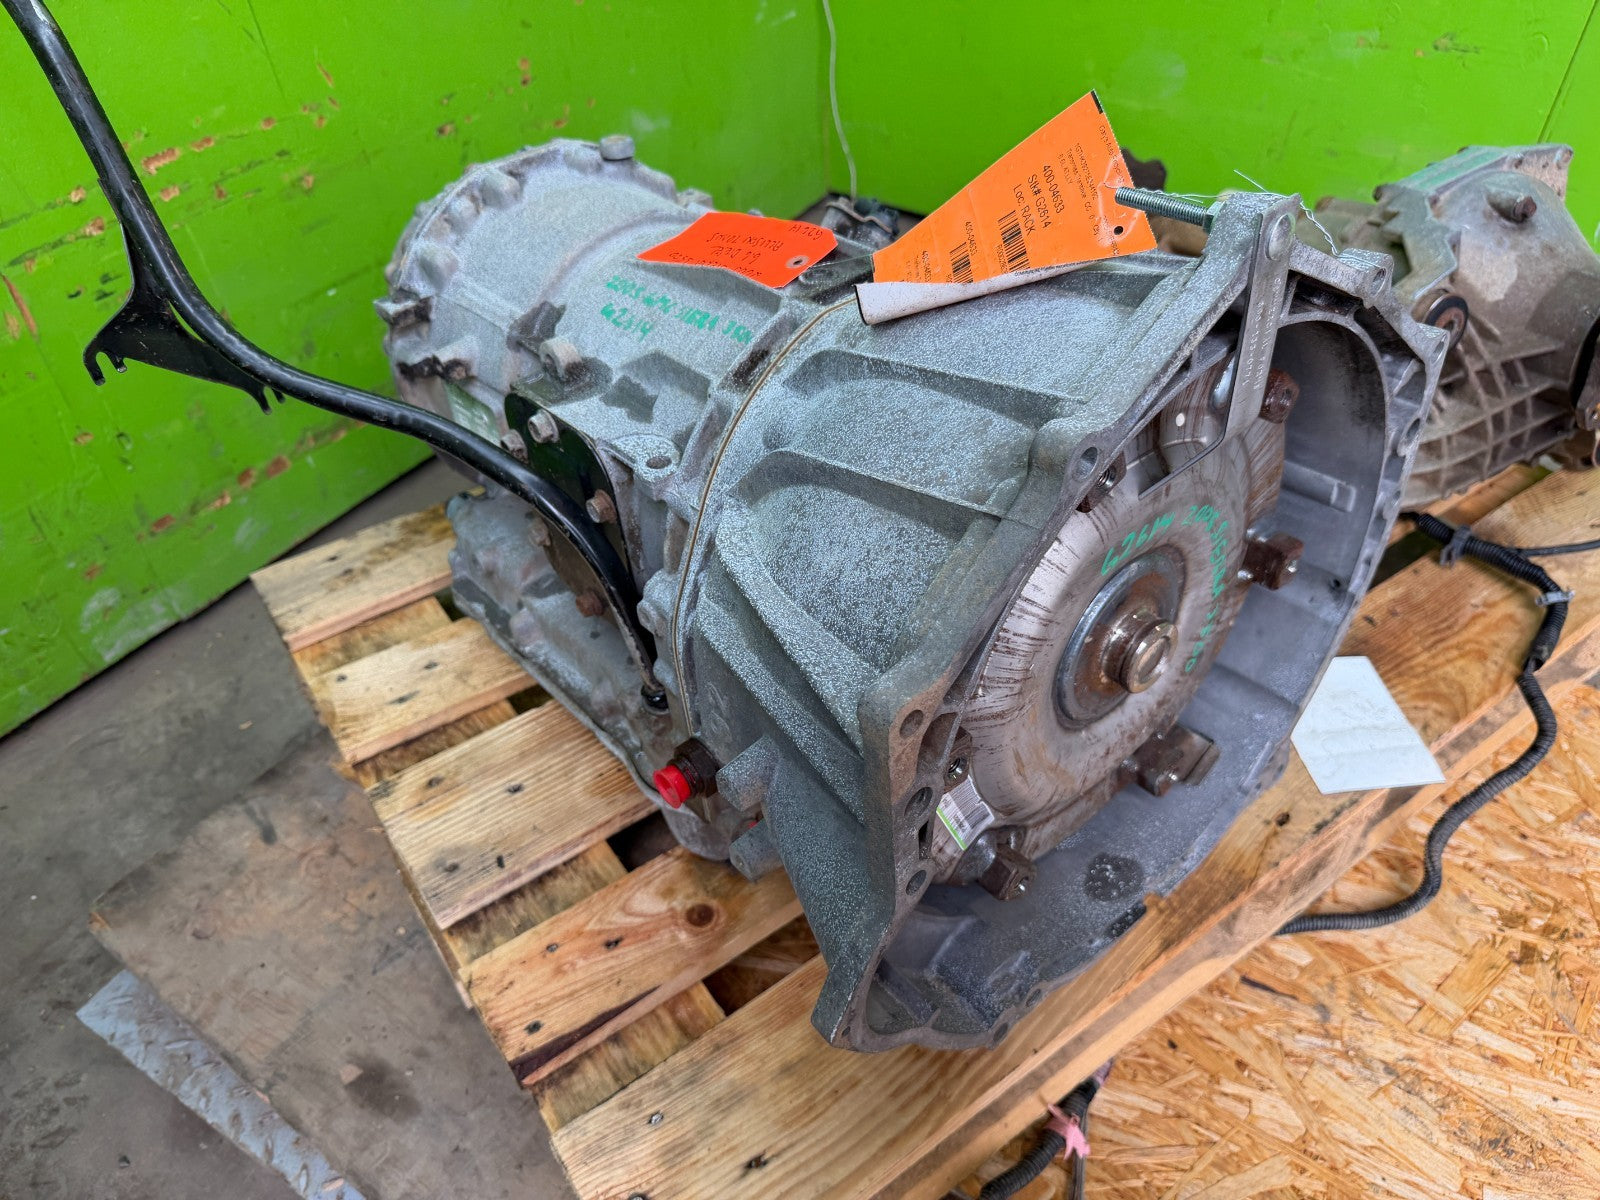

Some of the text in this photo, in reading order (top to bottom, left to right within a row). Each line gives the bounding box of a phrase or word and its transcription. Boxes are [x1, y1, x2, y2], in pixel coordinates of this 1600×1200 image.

[1012, 184, 1036, 236] Loc: RACK
[1027, 174, 1053, 229] Stk# G2614
[1041, 164, 1066, 214] 400-04633
[963, 221, 979, 256] 400-04633
